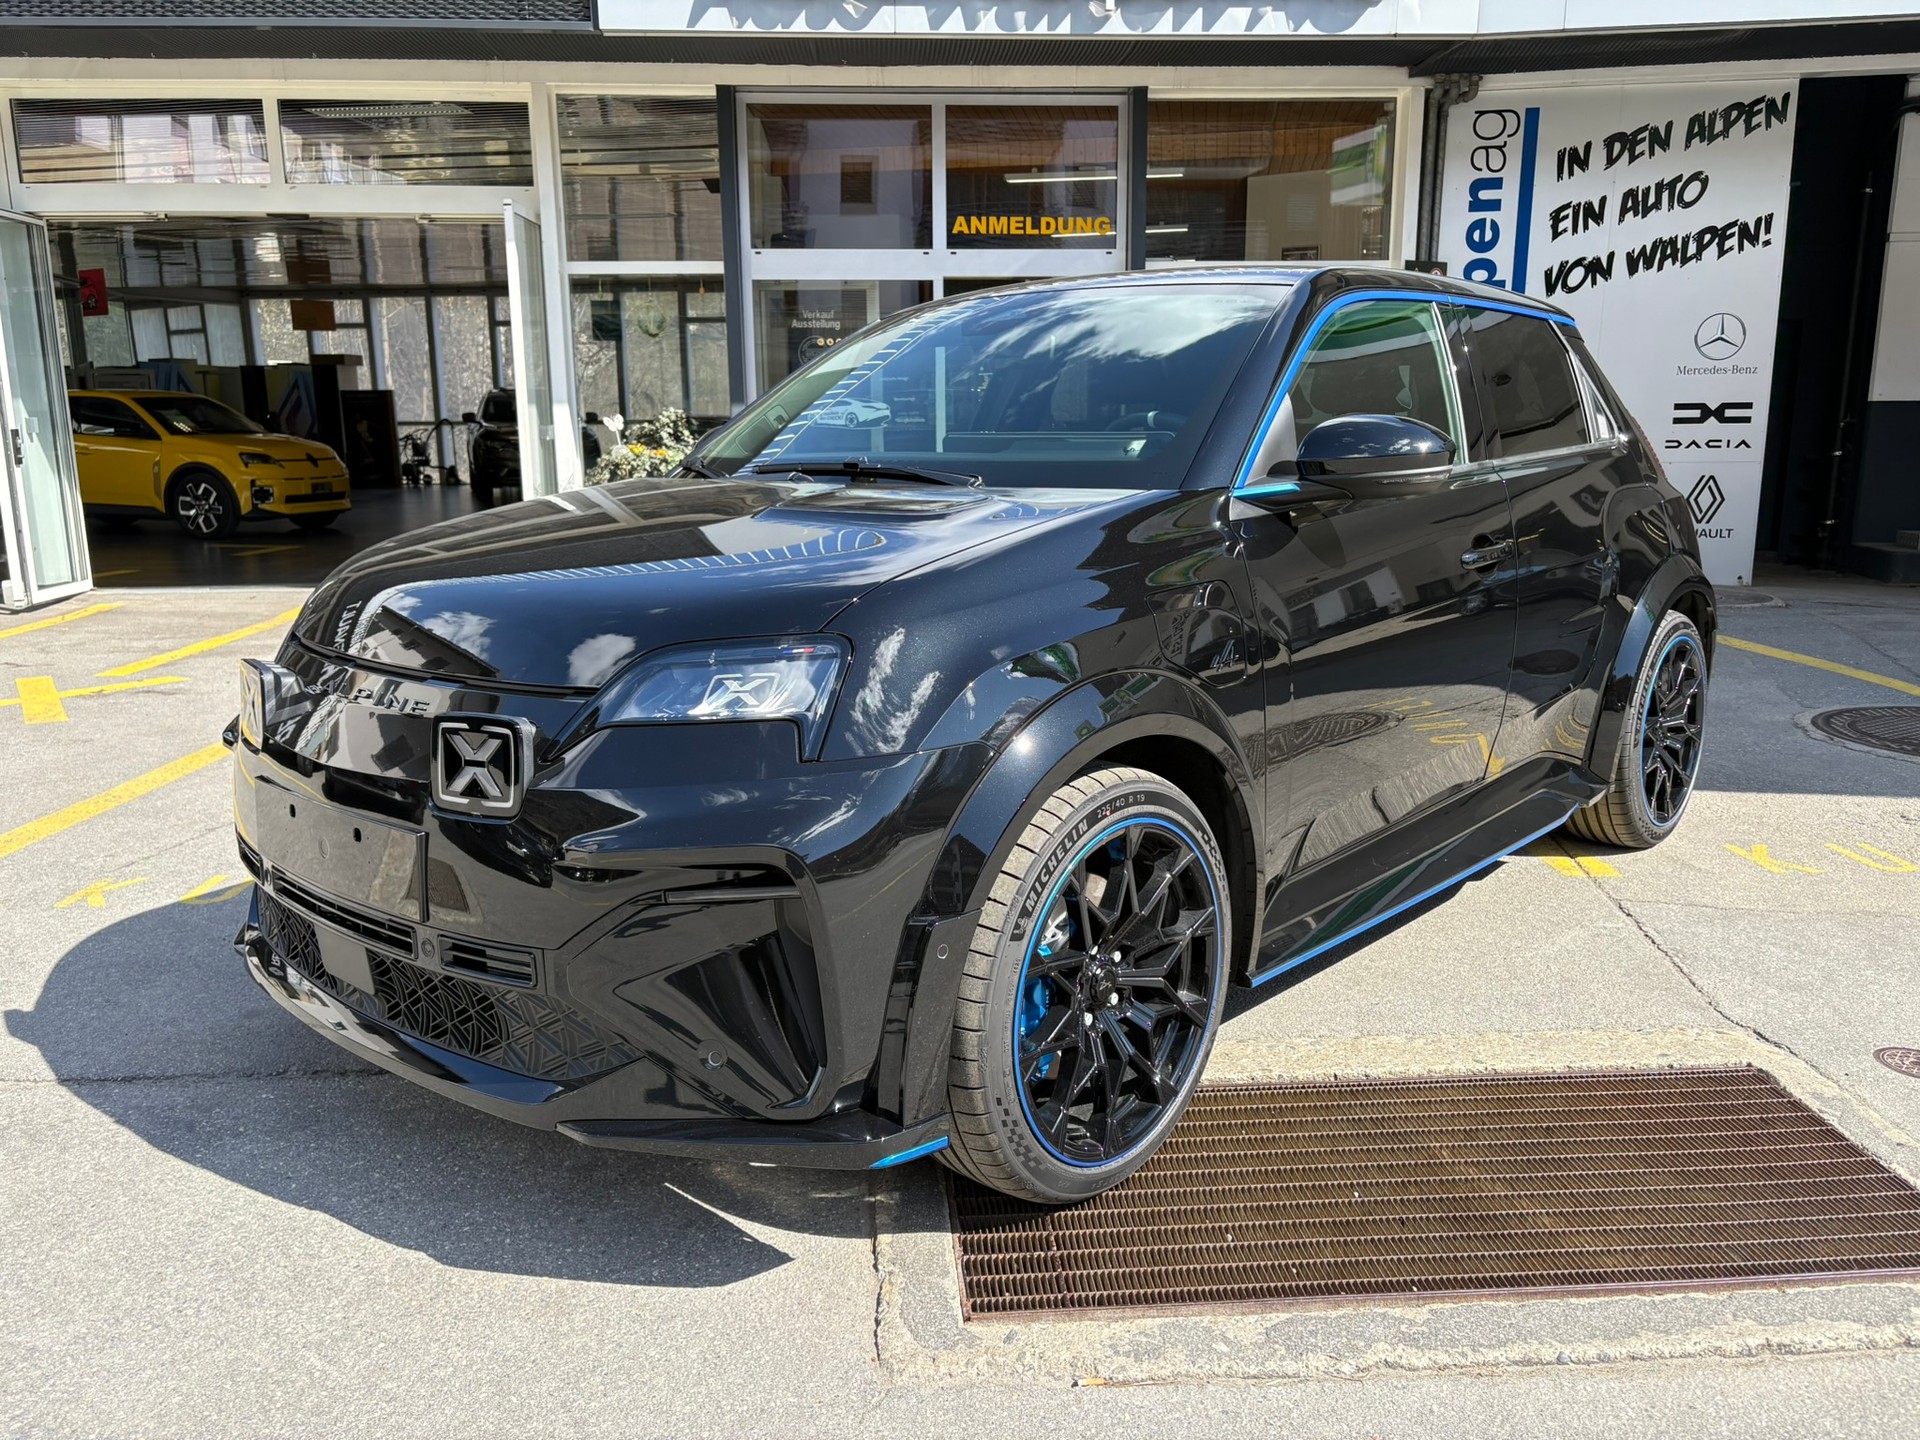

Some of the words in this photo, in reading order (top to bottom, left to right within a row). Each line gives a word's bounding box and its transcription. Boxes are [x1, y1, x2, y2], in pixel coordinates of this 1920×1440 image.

[1557, 140, 1592, 182] IN
[1603, 120, 1674, 171] DEN
[1684, 92, 1791, 151] ALPEN
[1549, 195, 1607, 242] EIN
[1618, 170, 1709, 225] AUTO
[952, 216, 1112, 235] ANMELDUNG
[1544, 251, 1615, 298] VON
[1625, 212, 1774, 279] WALPEN!
[791, 319, 841, 331] Ausstellung
[801, 309, 835, 319] Verkauf
[1676, 364, 1758, 376] Mercedes-Benz
[1664, 439, 1752, 449] DACIA
[1097, 798, 1126, 819] 225/40
[1136, 794, 1146, 802] 19
[1024, 819, 1090, 914] MICHELIN
